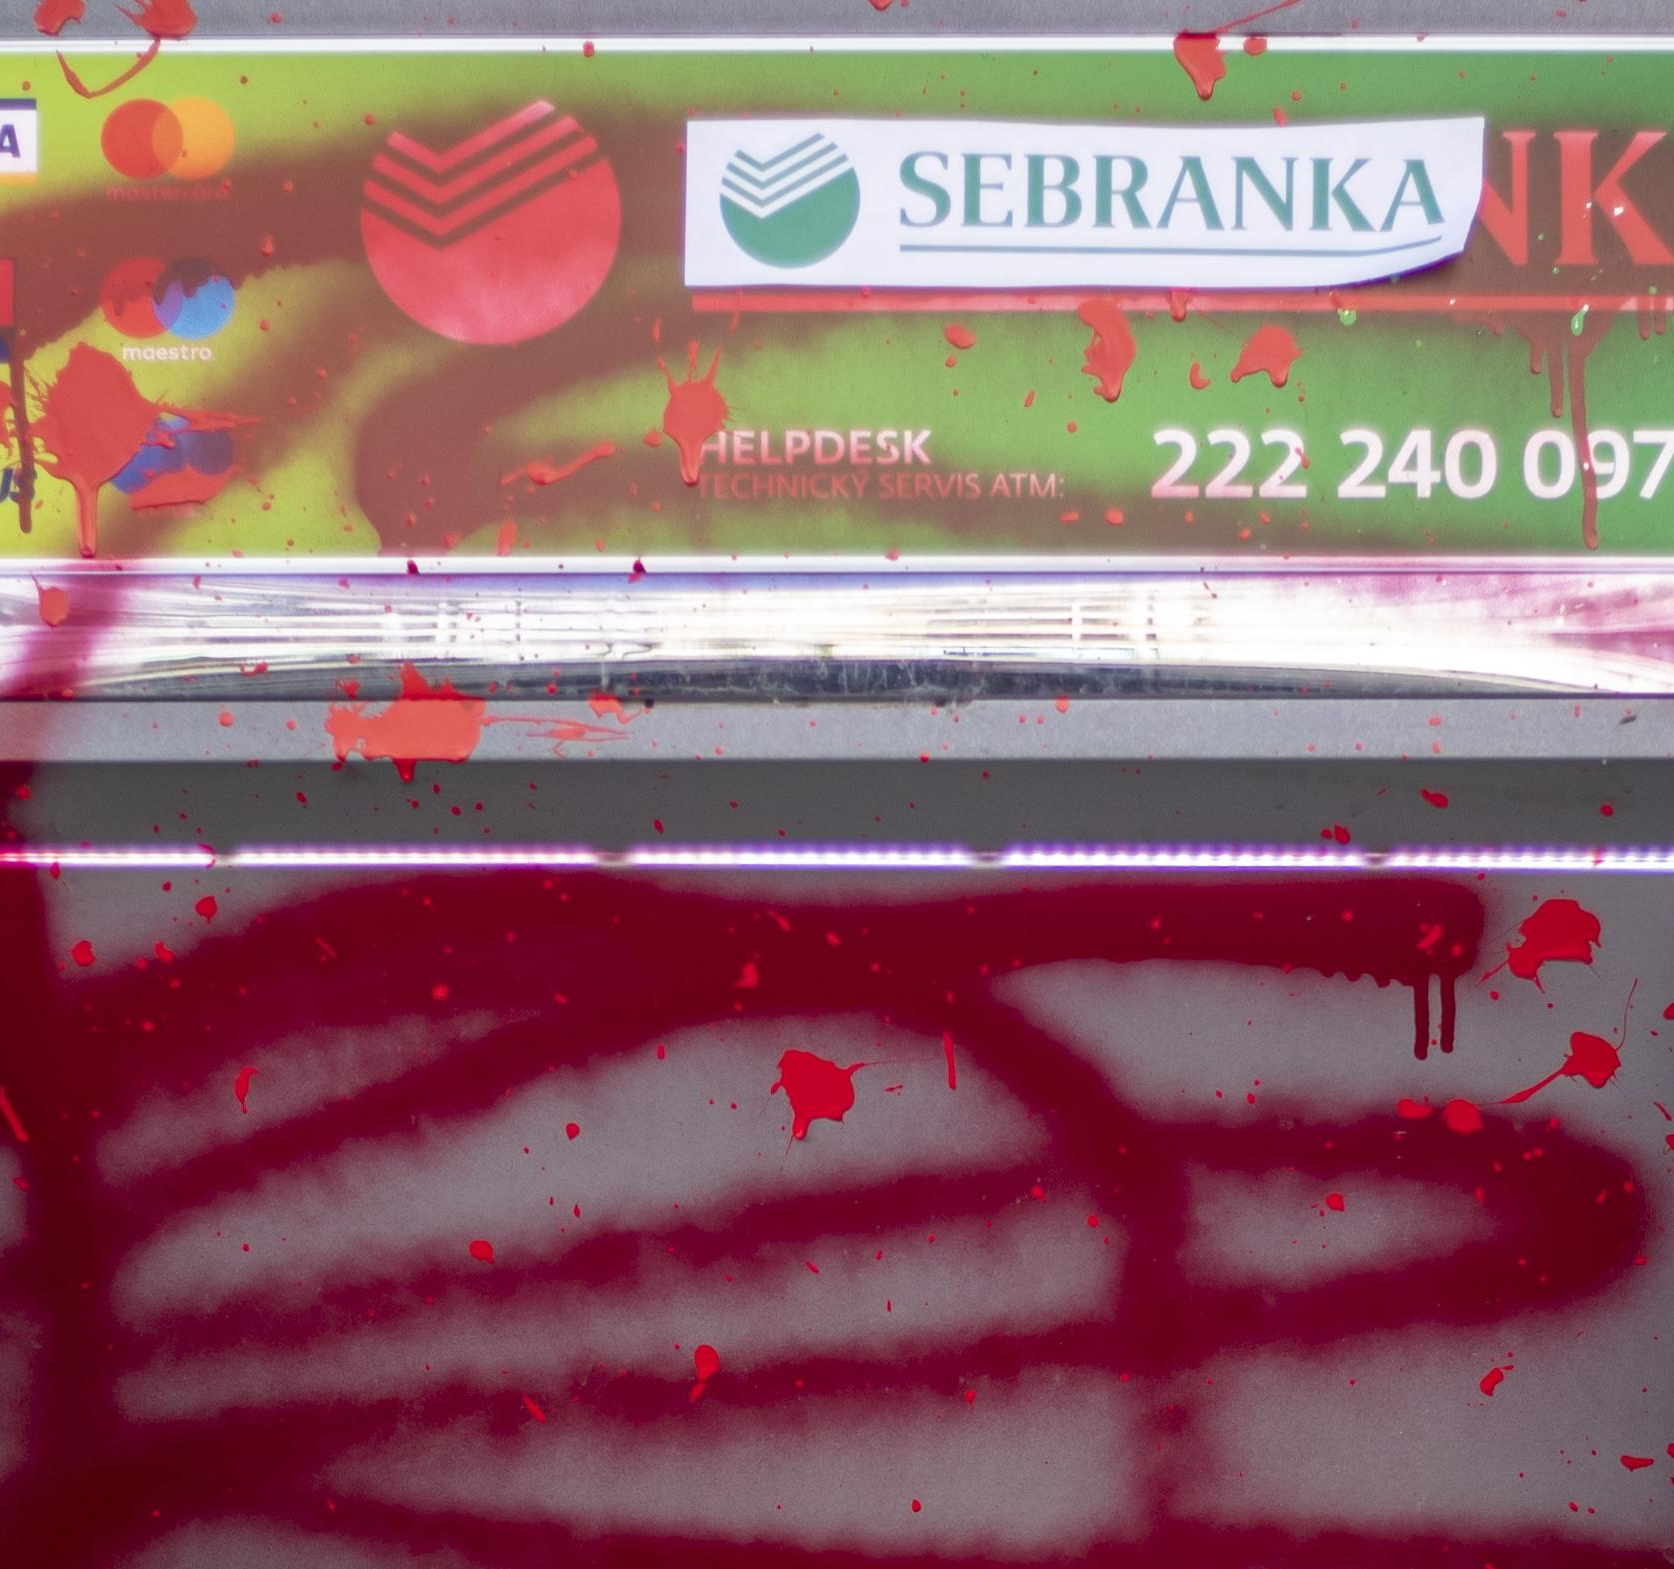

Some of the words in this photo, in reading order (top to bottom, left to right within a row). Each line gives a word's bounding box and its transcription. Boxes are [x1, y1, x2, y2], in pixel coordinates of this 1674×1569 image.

[898, 150, 1446, 232] SEBRANKA
[122, 344, 213, 363] maestro
[700, 428, 933, 466] HELPDESK
[1150, 428, 1308, 499] 222
[1335, 428, 1499, 499] 240
[879, 472, 982, 500] SERVIS
[989, 472, 1066, 500] ATM:
